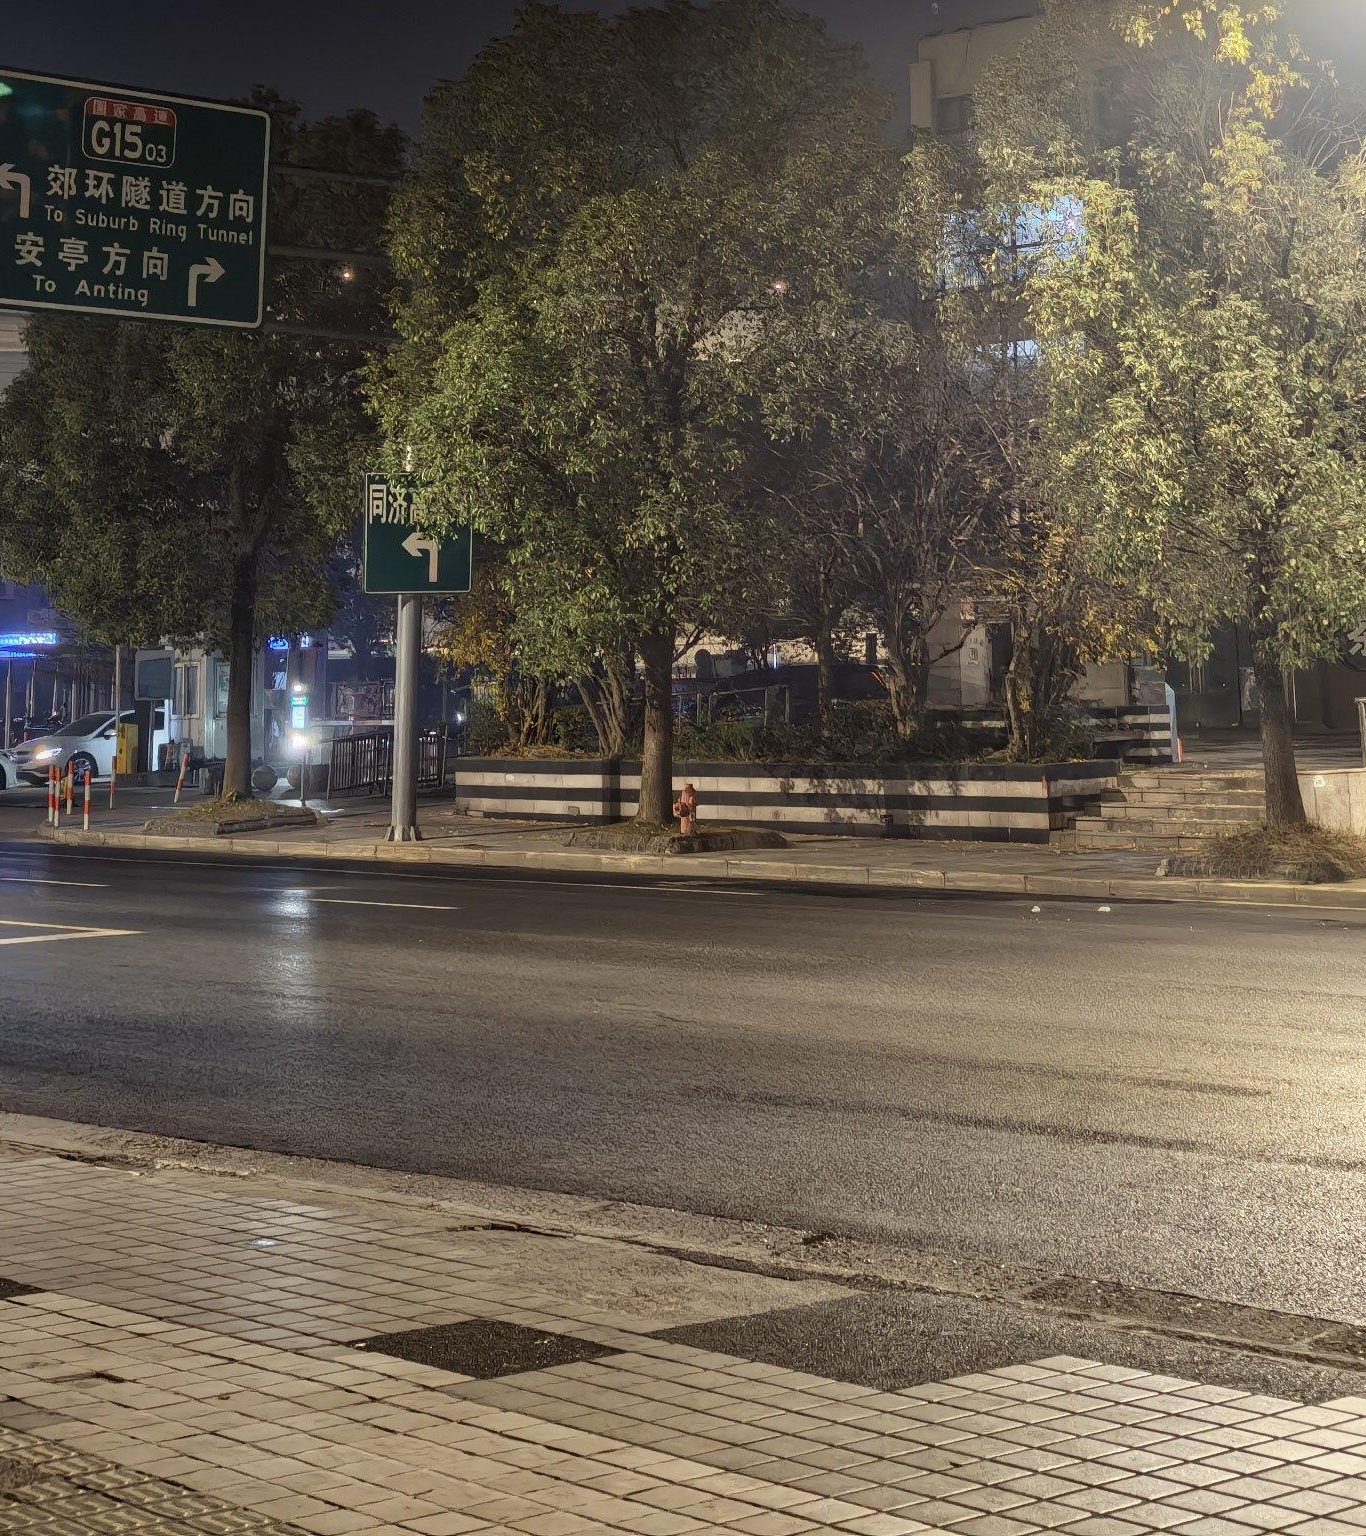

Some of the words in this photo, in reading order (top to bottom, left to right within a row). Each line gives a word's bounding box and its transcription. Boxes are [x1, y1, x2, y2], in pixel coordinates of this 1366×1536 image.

[45, 164, 254, 224] 郊环隧道方向
[44, 204, 64, 223] To
[75, 209, 139, 232] Suburb
[149, 218, 187, 243] Ring
[197, 224, 254, 246] Tunnel
[14, 231, 169, 281] 安亭方向
[32, 274, 57, 294] To
[75, 279, 149, 307] Anting
